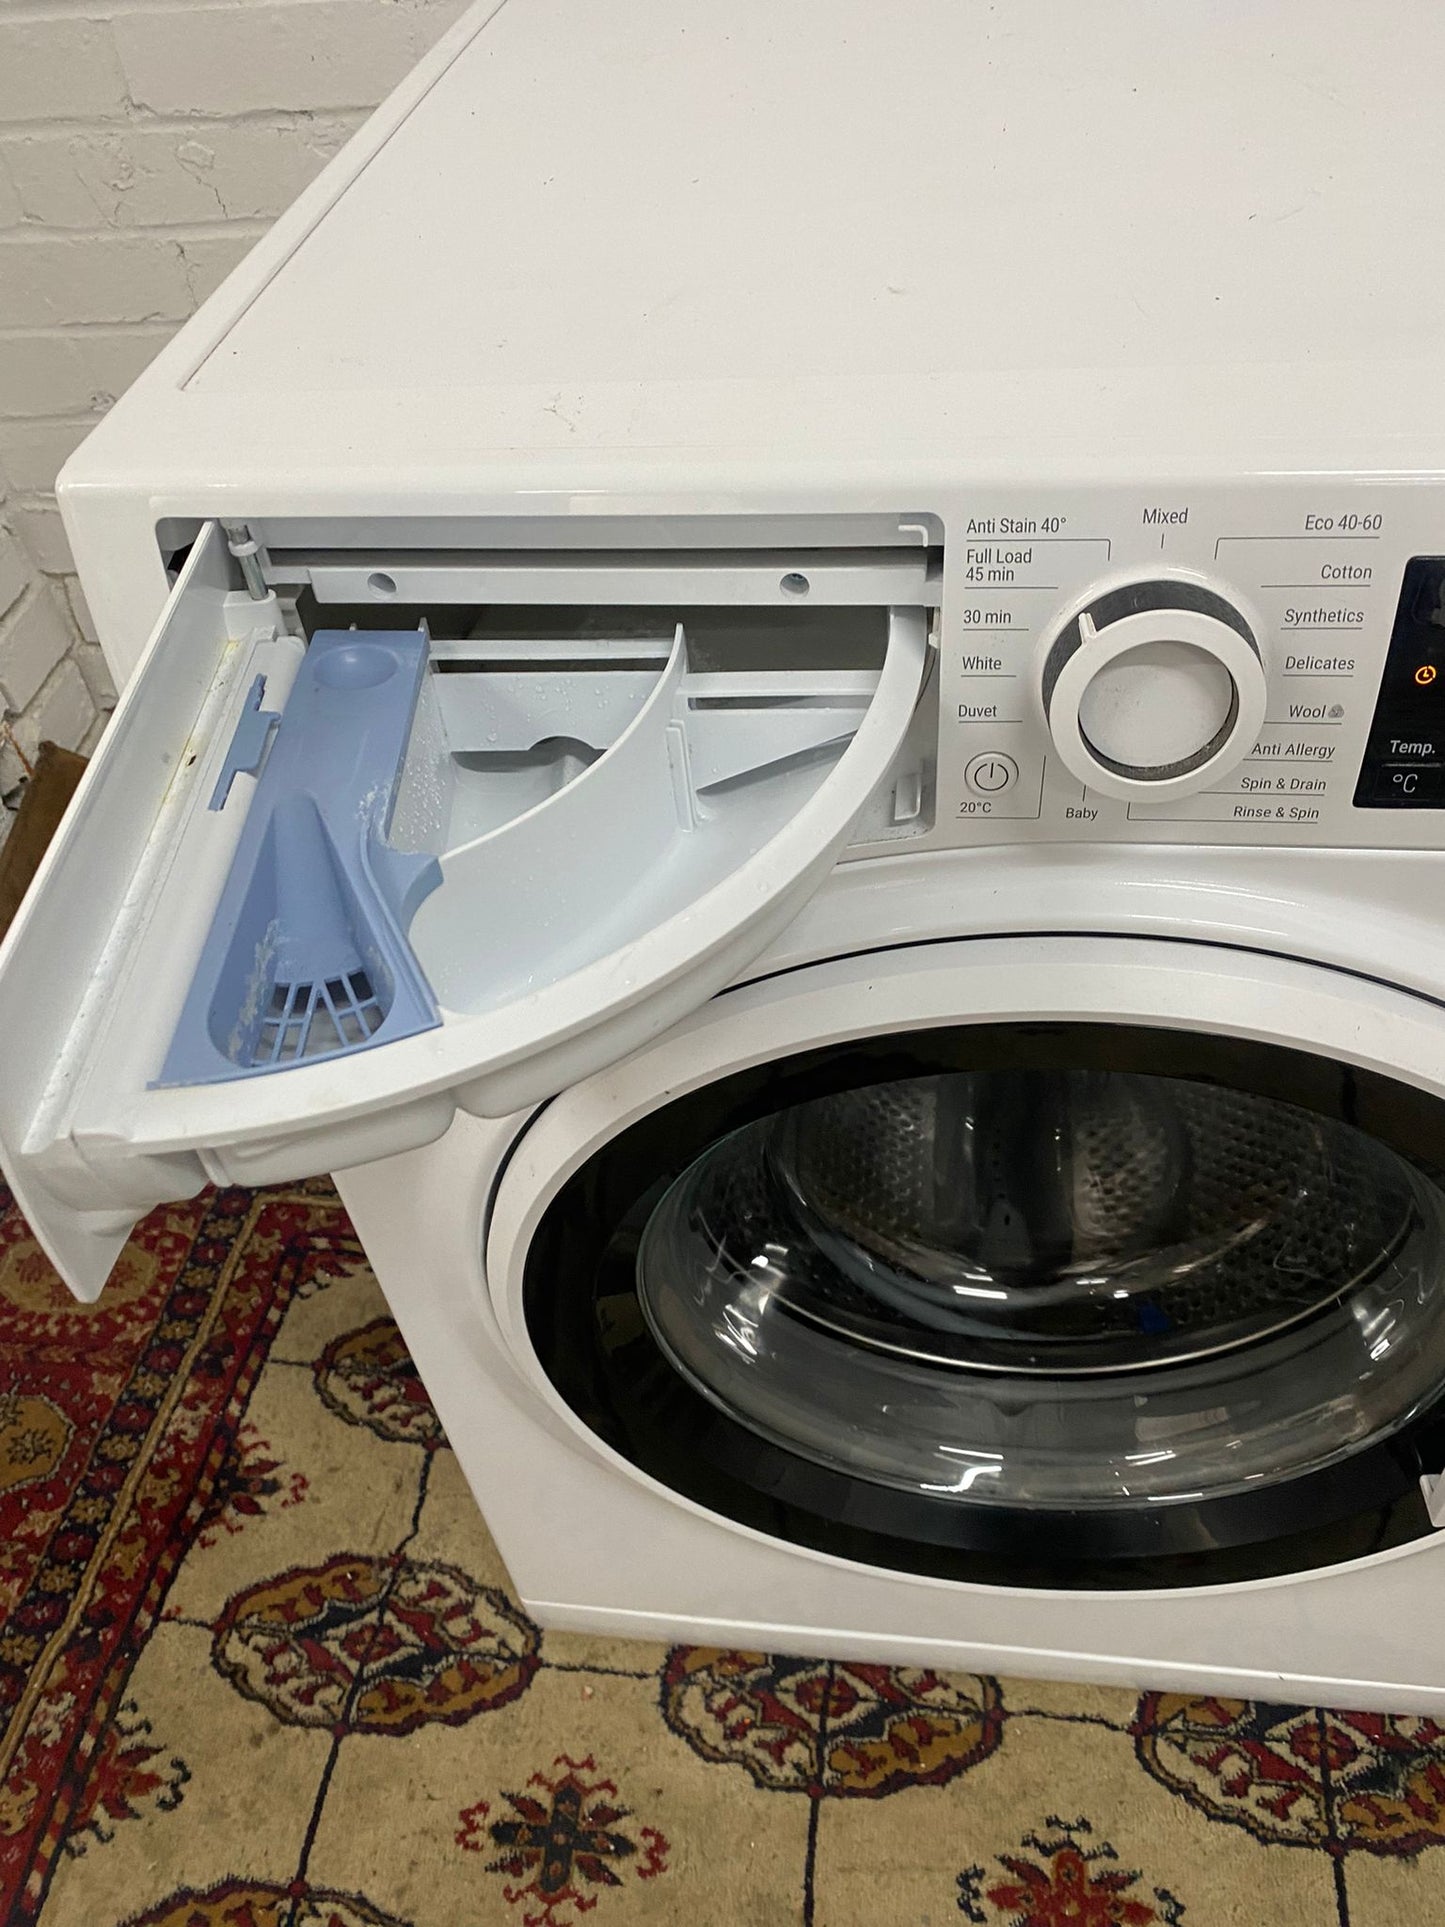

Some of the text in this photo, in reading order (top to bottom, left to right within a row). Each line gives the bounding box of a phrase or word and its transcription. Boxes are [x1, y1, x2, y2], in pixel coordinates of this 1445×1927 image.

[1142, 508, 1188, 524] Mixed
[1304, 514, 1383, 531] Eco 40-60
[966, 518, 996, 534] Anti
[999, 518, 1037, 534] Stain
[967, 549, 1032, 564] Full Load
[965, 567, 1014, 582] 45 min
[1320, 565, 1372, 579] Cotton
[963, 610, 1012, 624] 30 min
[1284, 608, 1364, 626] Synthetics
[962, 656, 1002, 670] White
[1285, 656, 1355, 670] Delicates
[958, 705, 997, 718] Duvet
[1288, 705, 1326, 718] Wool
[1251, 744, 1336, 759] Anti Allergy
[1390, 740, 1435, 757] Temp.
[1240, 778, 1327, 792] Spin & Drain
[1065, 807, 1098, 821] Baby
[1233, 806, 1319, 821] Rinse & Spin
